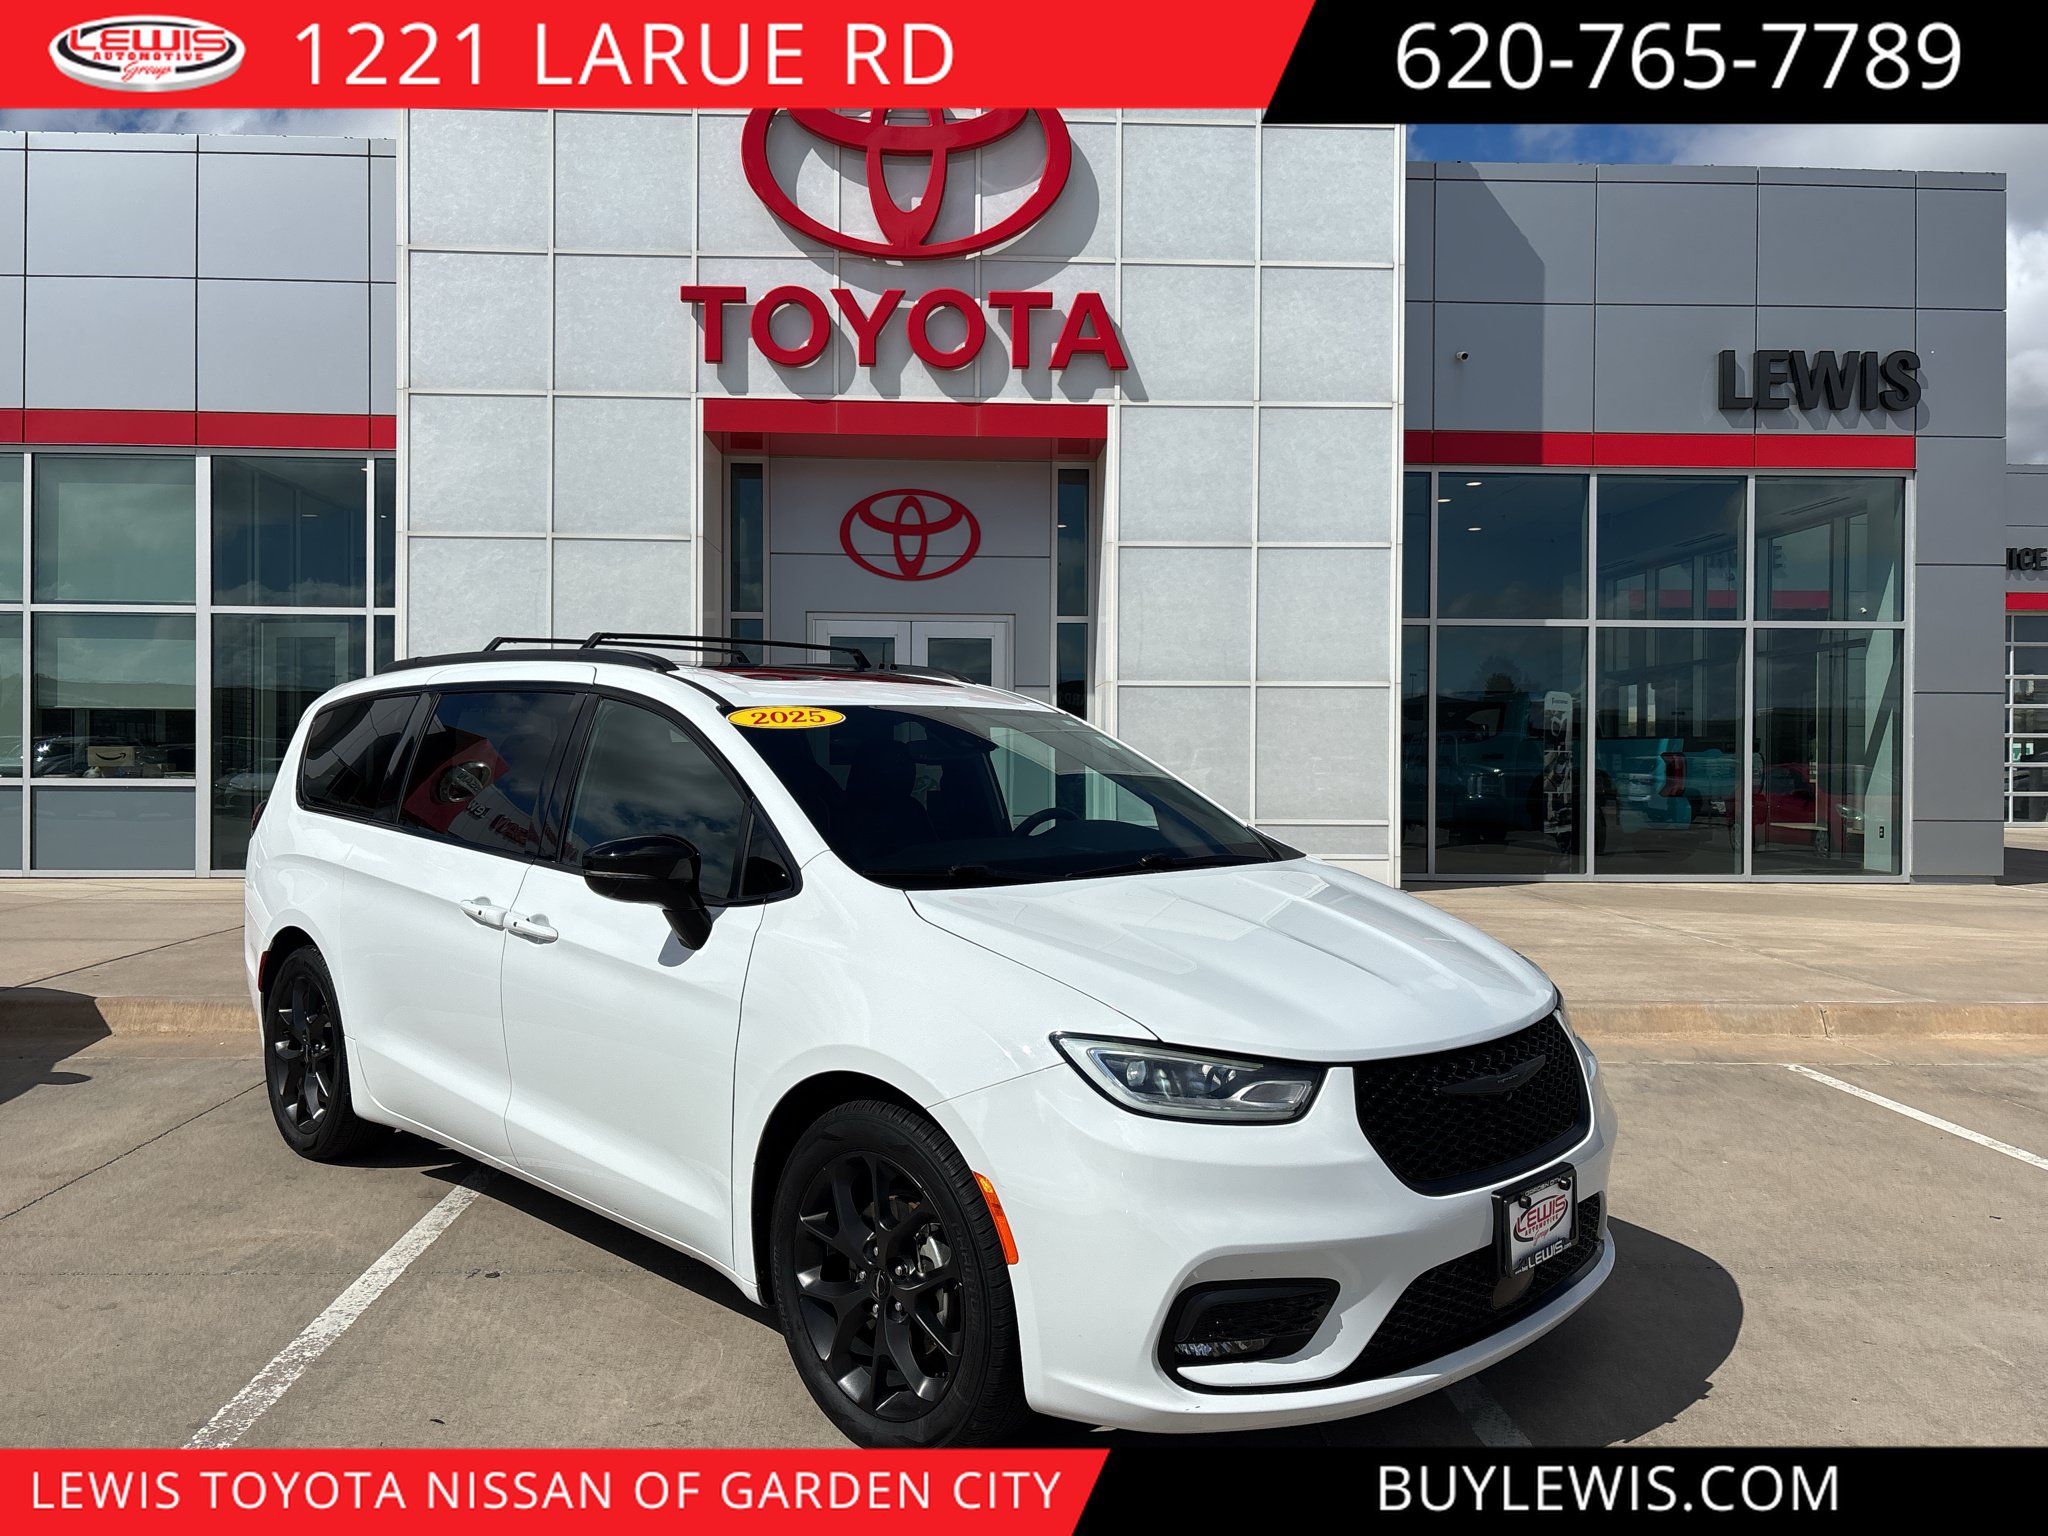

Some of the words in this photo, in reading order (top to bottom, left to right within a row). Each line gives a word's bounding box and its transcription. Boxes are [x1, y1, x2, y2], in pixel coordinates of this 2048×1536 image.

[680, 284, 1129, 371] TOYOTA
[1718, 349, 1922, 412] LEWIS
[2005, 547, 2048, 571] ICE
[750, 710, 826, 725] 2025
[1516, 1194, 1566, 1233] LEWIS
